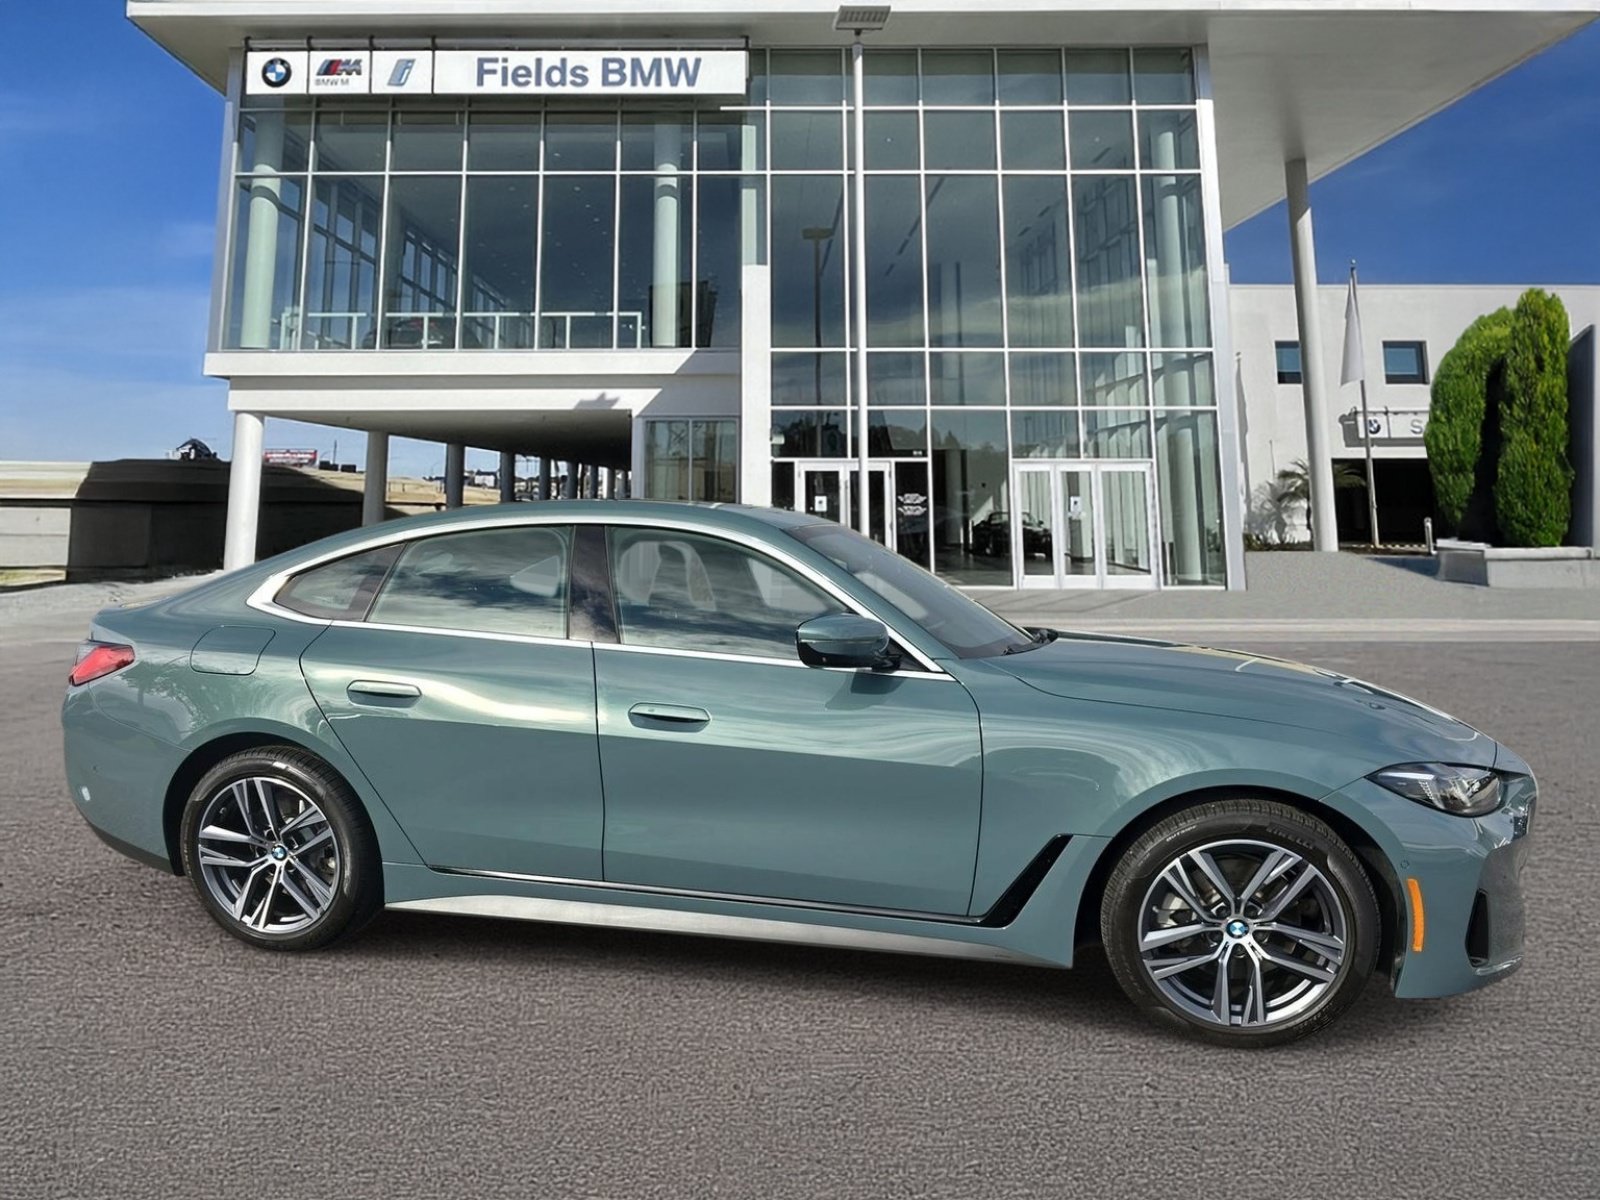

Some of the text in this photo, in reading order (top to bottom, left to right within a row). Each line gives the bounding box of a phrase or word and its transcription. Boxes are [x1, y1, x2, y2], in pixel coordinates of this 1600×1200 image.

[314, 78, 339, 86] BMW
[476, 57, 702, 88] Fields BMW
